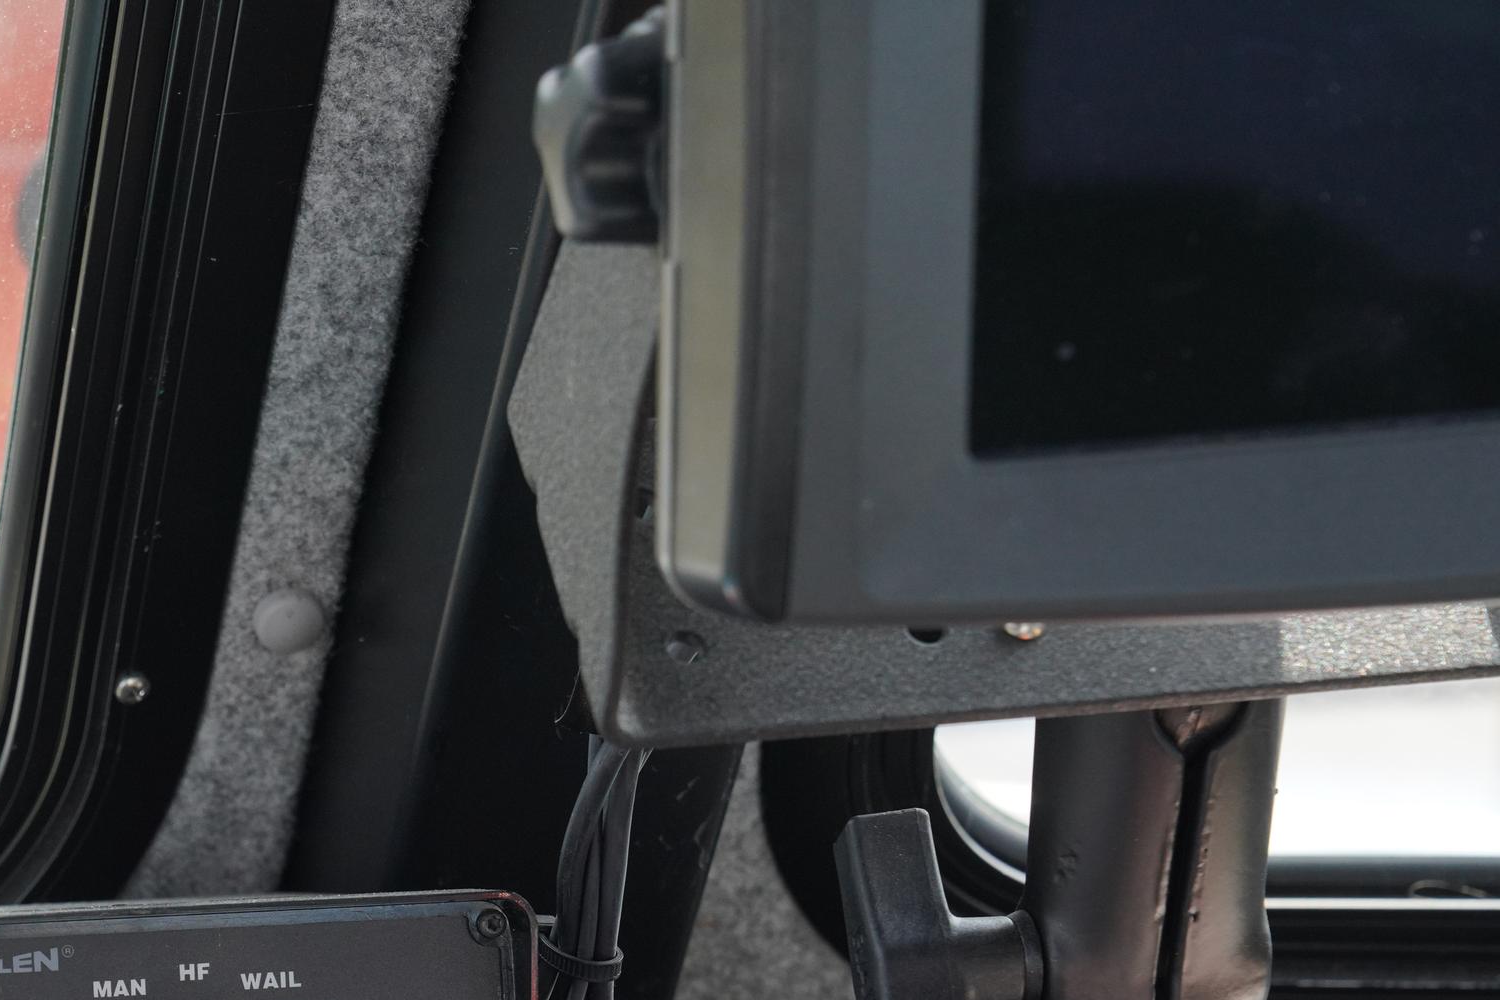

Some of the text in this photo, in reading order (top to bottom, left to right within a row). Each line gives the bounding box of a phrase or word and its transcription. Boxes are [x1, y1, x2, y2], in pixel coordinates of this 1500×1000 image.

[179, 962, 210, 981] HF
[239, 970, 302, 990] WAIL
[92, 978, 147, 998] MAN
